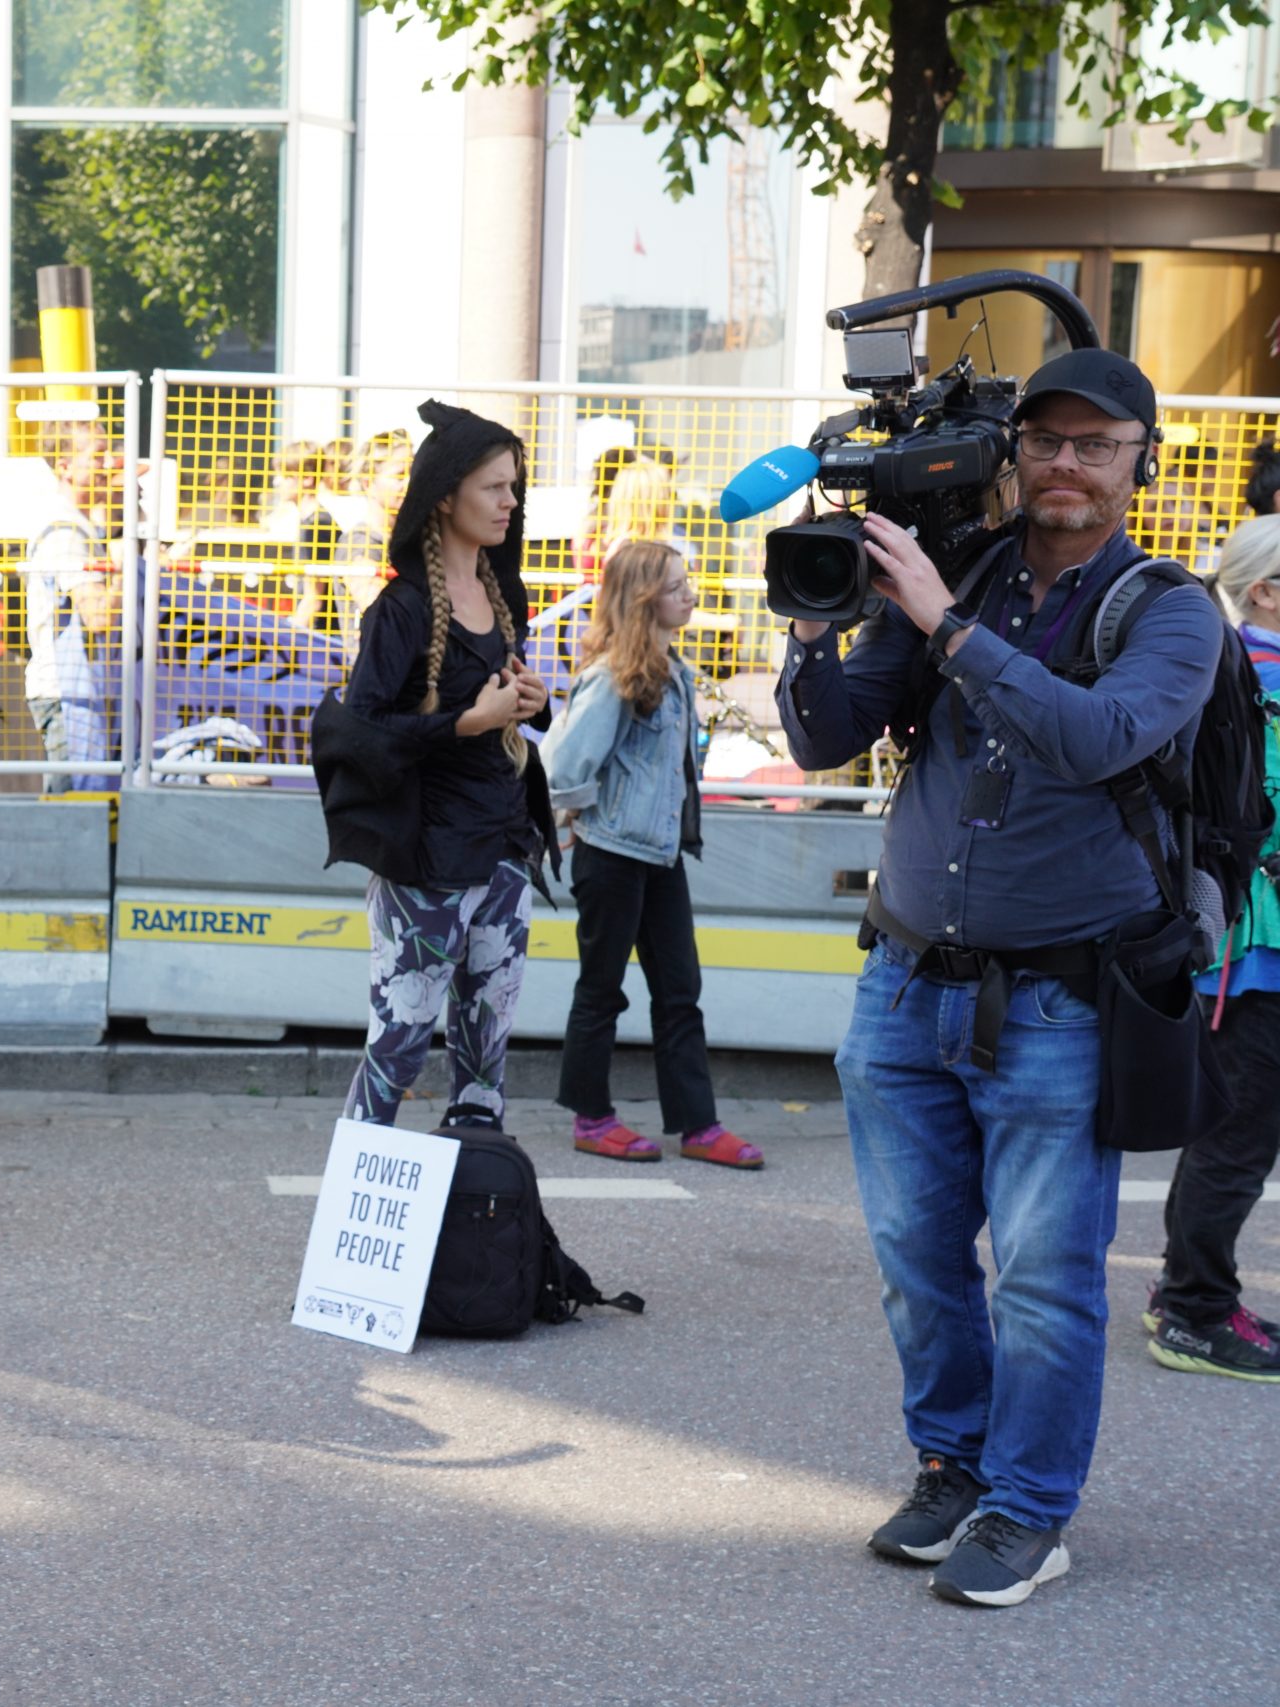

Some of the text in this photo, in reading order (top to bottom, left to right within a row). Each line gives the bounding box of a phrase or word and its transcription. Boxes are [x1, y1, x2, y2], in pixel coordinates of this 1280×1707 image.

[131, 908, 271, 935] RAMIRENT
[354, 1152, 422, 1191] POWER
[349, 1192, 410, 1230] TO THE
[336, 1231, 405, 1272] PEOPLE
